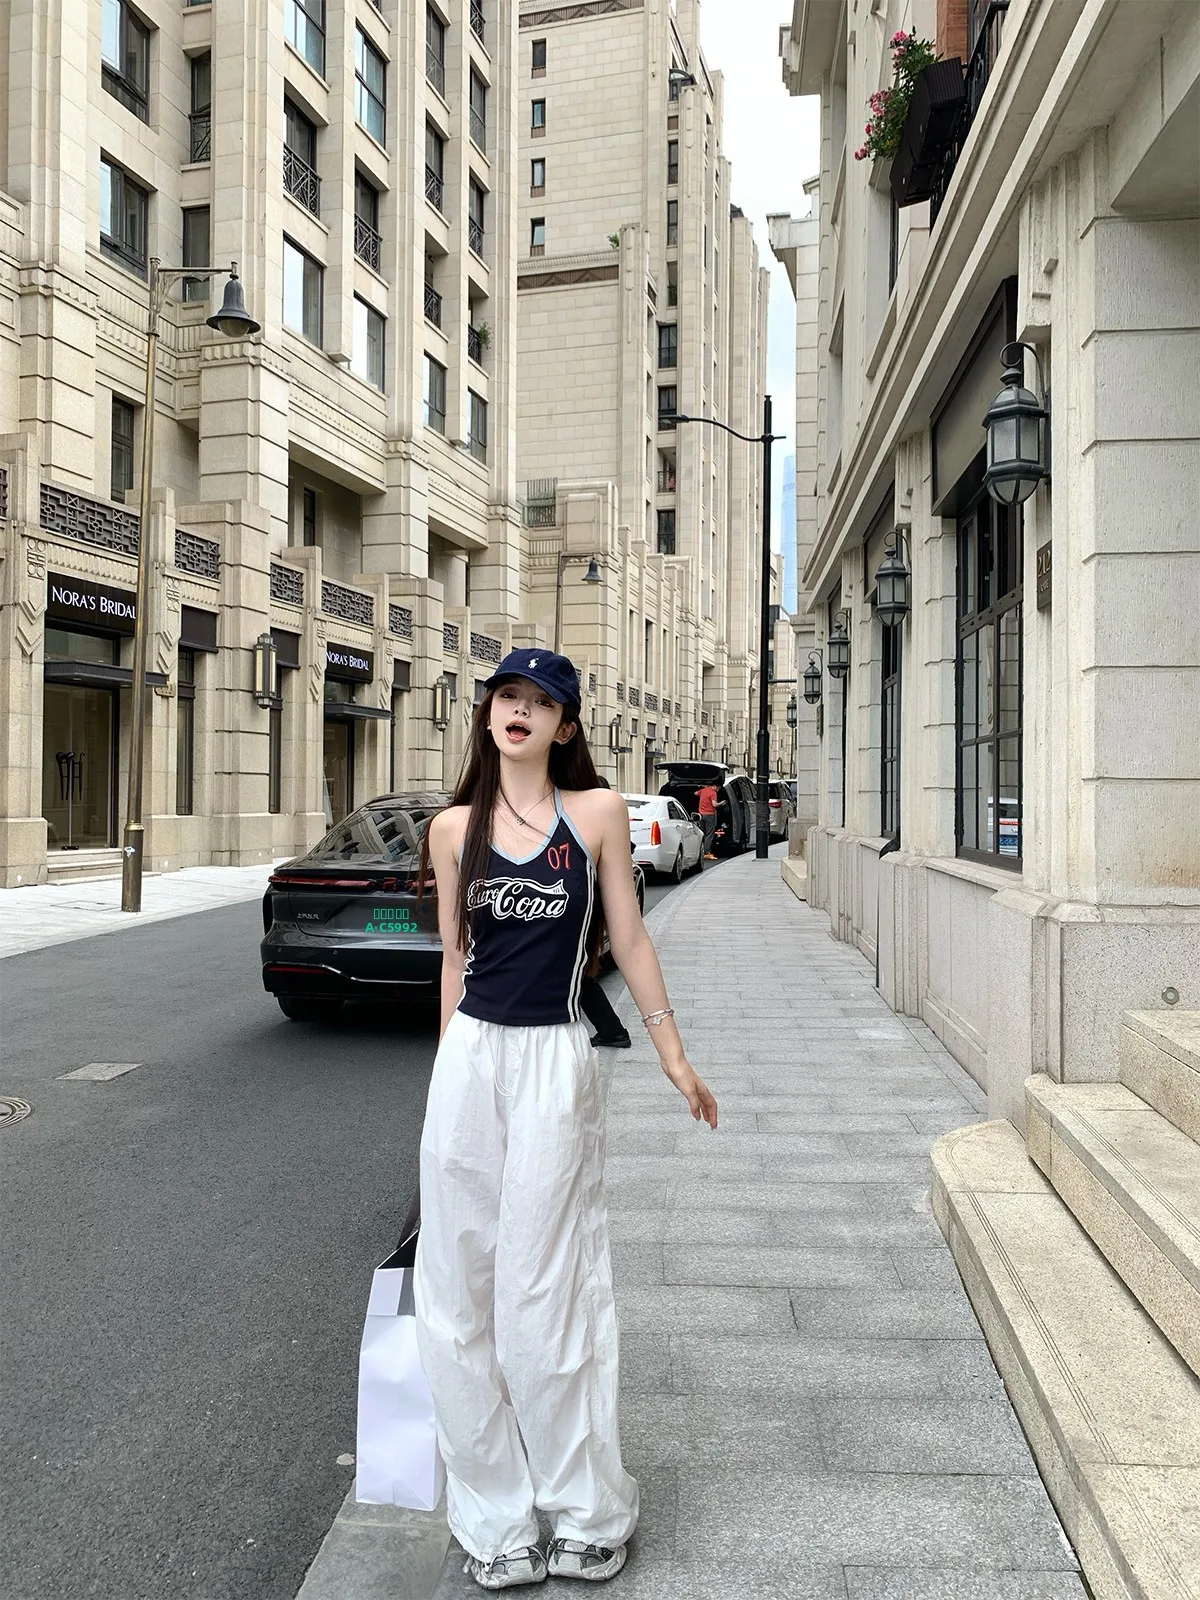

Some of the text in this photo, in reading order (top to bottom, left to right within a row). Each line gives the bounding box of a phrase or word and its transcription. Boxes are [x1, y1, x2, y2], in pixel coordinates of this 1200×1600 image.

[52, 585, 137, 620] NORA'S BRIDAL
[326, 651, 370, 671] NORA'S BRIDAL
[547, 842, 571, 871] 07
[467, 880, 566, 919] Euro Copa
